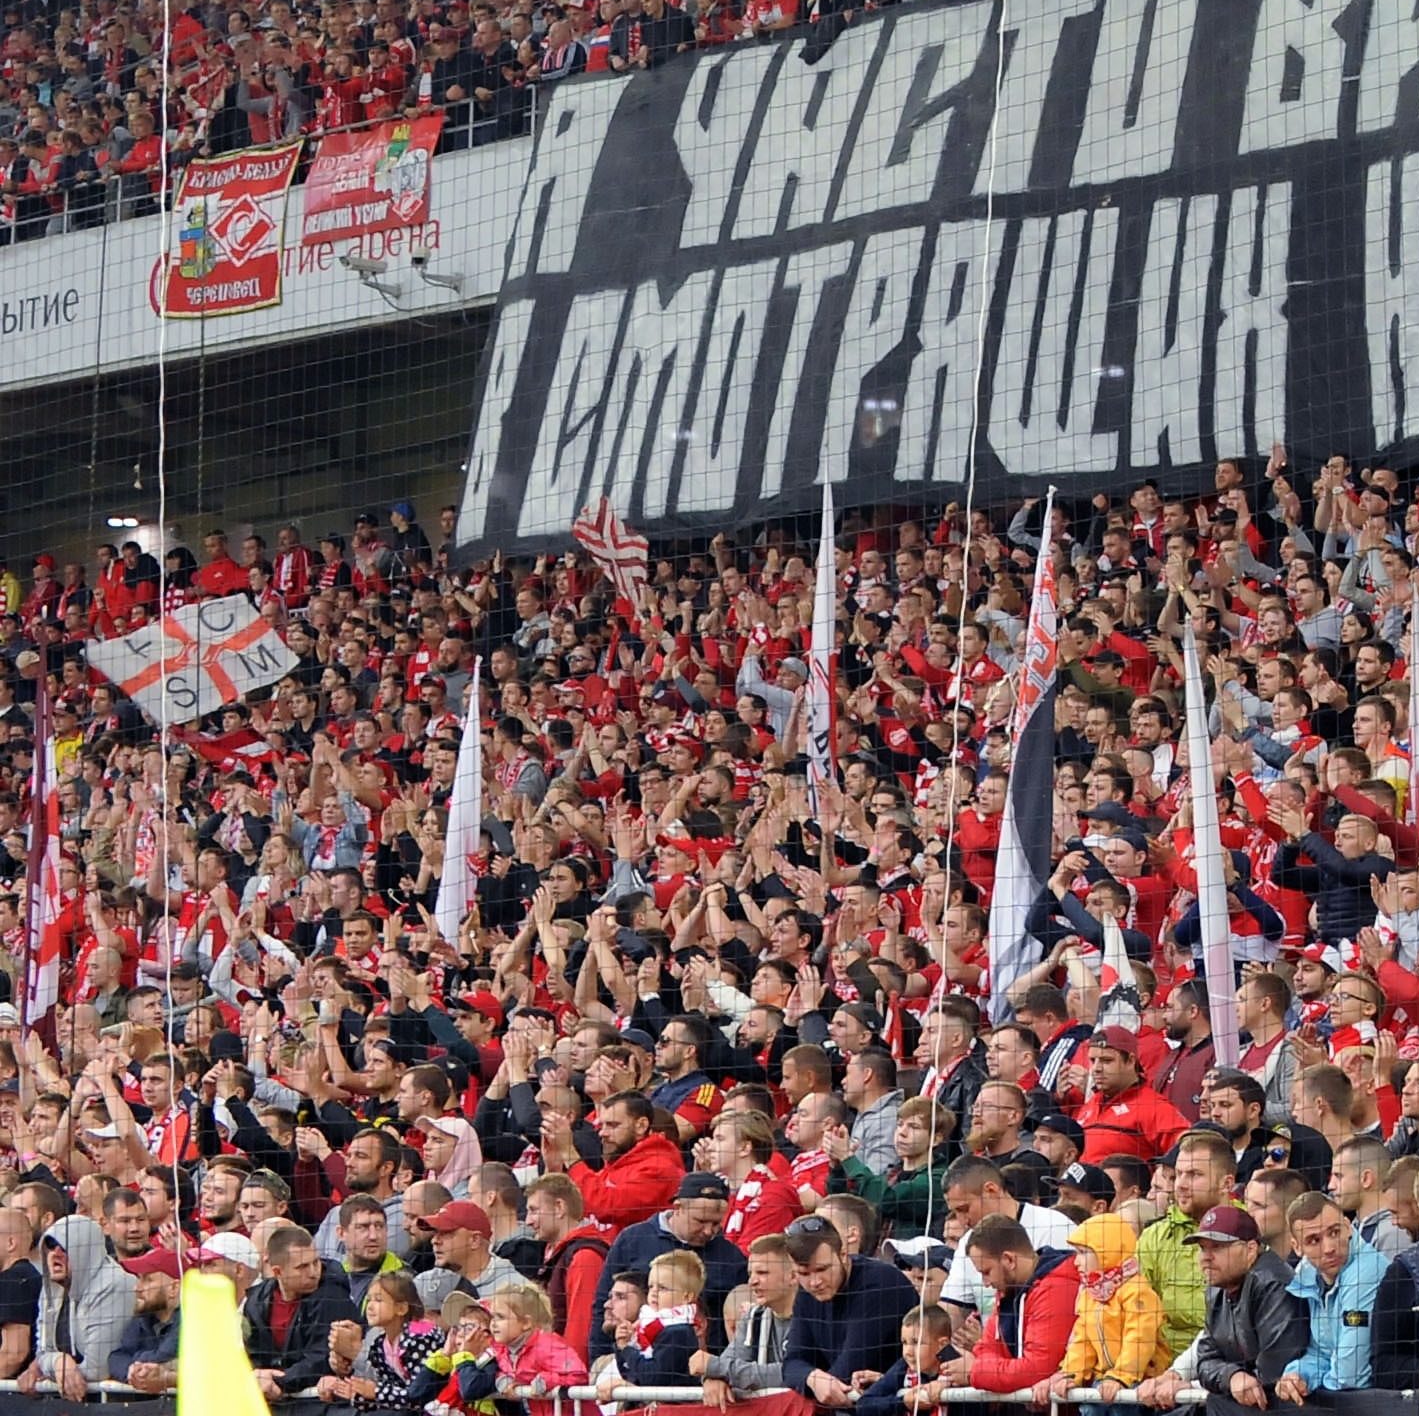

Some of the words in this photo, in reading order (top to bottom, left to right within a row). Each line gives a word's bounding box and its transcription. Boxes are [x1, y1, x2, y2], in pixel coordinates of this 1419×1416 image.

[508, 75, 634, 280] Я
[456, 299, 535, 547] В
[517, 182, 1292, 537] СМОТРЯЩИХ
